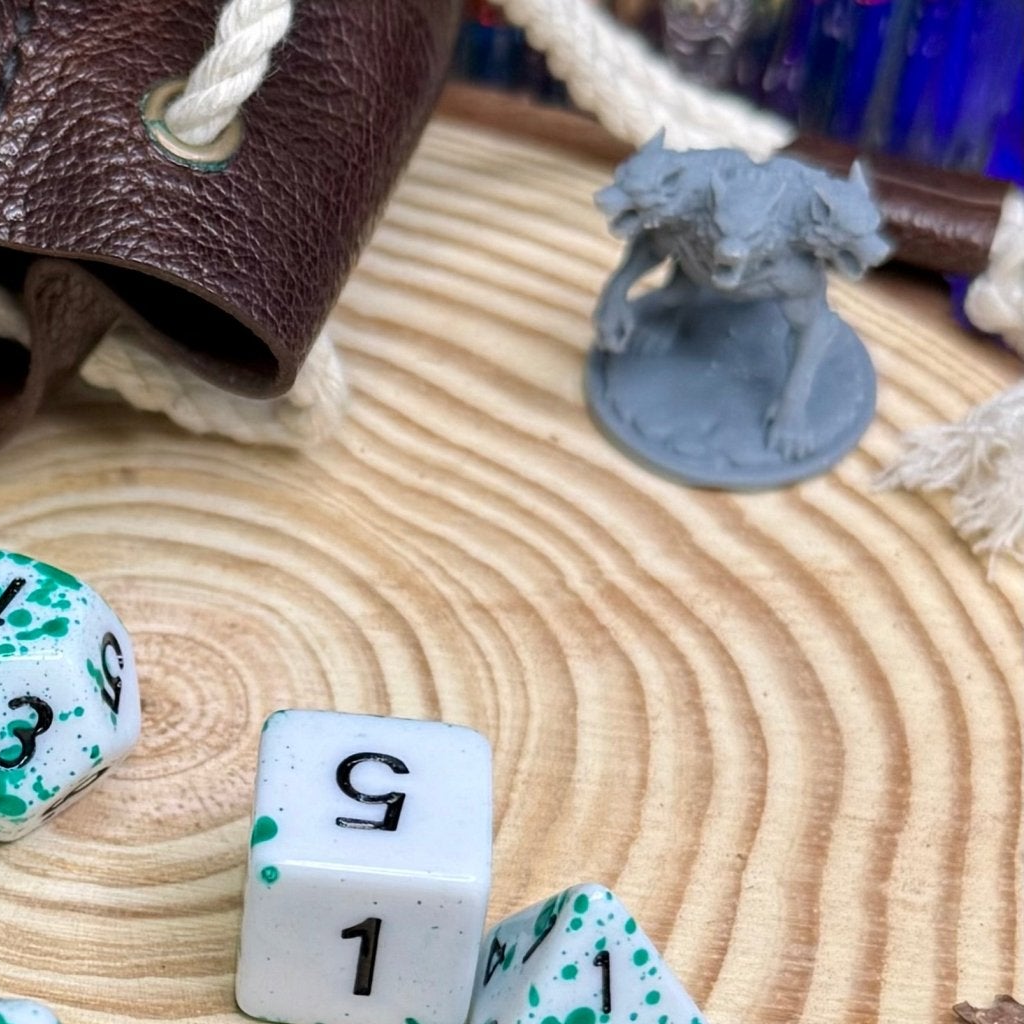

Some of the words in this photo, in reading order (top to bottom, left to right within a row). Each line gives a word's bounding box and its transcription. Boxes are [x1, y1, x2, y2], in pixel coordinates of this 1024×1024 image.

[335, 751, 411, 832] 5
[341, 917, 383, 996] 1
[593, 950, 611, 1014] 1
